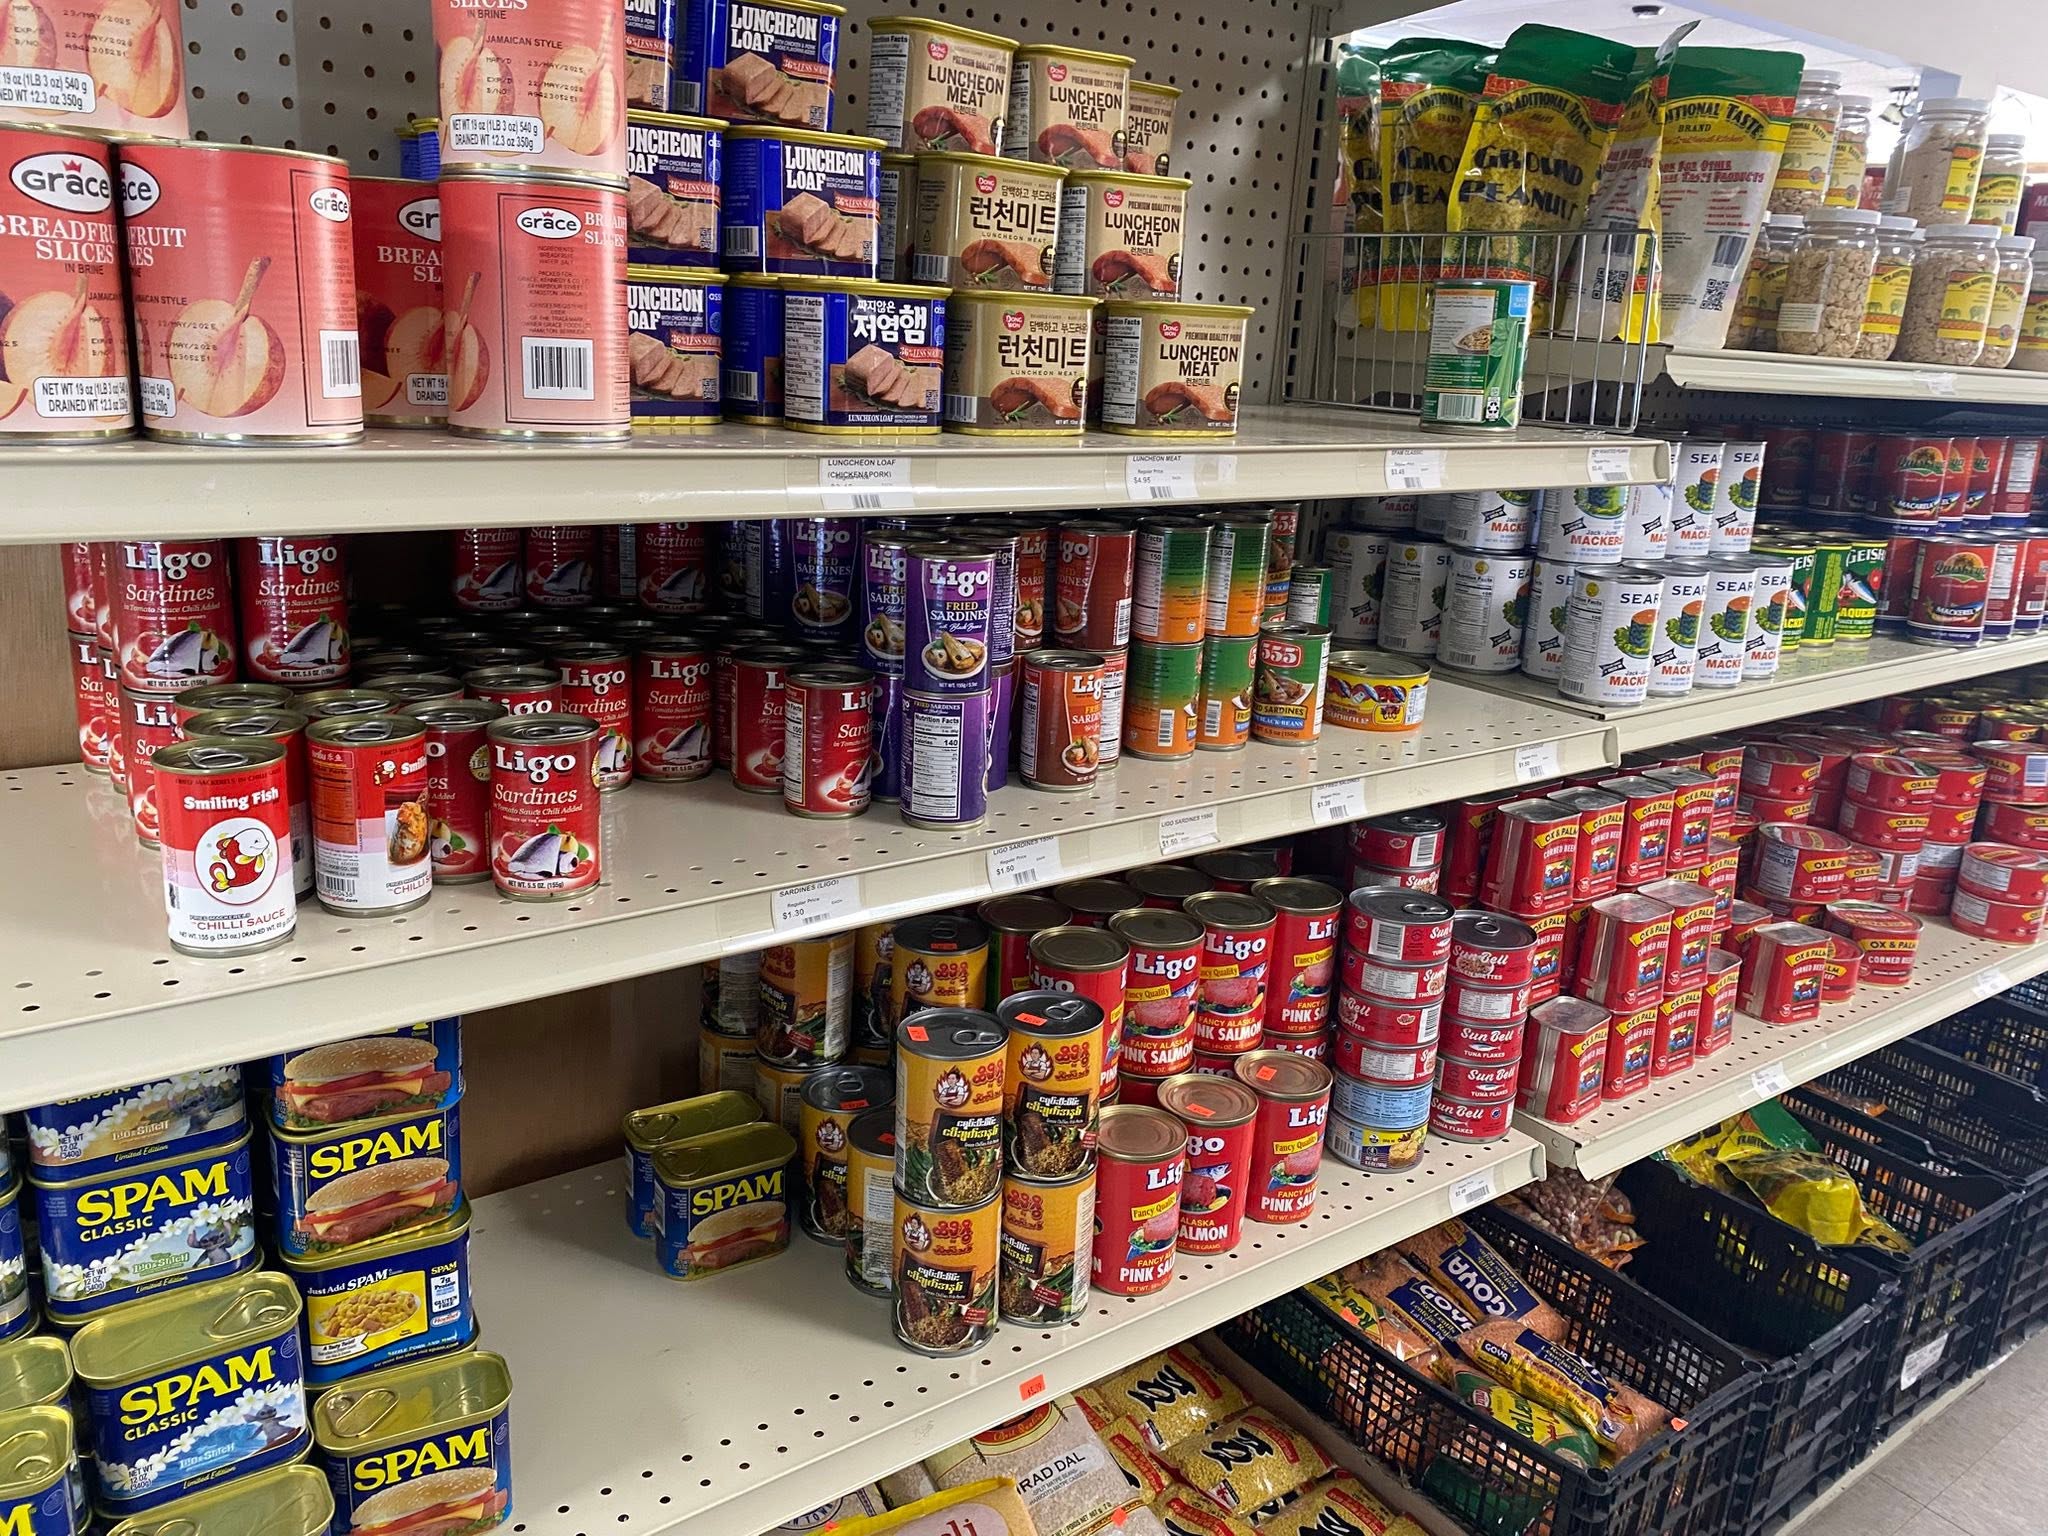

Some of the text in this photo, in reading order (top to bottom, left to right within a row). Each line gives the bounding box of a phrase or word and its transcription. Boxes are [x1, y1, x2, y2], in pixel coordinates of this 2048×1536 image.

[478, 10, 507, 19] BRINE
[730, 4, 819, 41] LUNCHEON
[486, 34, 563, 49] JAMAICAN STYLE
[730, 27, 775, 53] LOAF
[50, 78, 63, 90] oz)
[65, 77, 79, 91] 540
[928, 64, 1005, 96] LUNCHEON
[15, 89, 83, 110] WT oz 350g
[946, 84, 986, 109] MEAT
[1049, 86, 1123, 112] LUNCHEON
[1067, 104, 1106, 123] MEAT
[520, 121, 531, 133] 540
[1127, 115, 1169, 135] CHEON
[1678, 123, 1712, 133] BRAND
[480, 136, 490, 145] WT
[628, 126, 704, 159] UNCHEON
[784, 145, 865, 178] LUNCHEON
[1475, 145, 1583, 186] GROUND
[21, 168, 110, 198] Grace
[786, 170, 827, 191] LOAF
[1001, 185, 1030, 200] 담백하고
[313, 197, 348, 214] Grace
[521, 216, 577, 231] Grace
[969, 196, 1057, 236] 런천미트
[1104, 212, 1180, 233] LUNCHEON
[1123, 229, 1163, 248] MEAT
[36, 238, 114, 264] SLICES
[77, 264, 104, 275] BRINE
[628, 285, 705, 314] UNCHEON
[855, 299, 896, 314] 짜지않은
[852, 304, 928, 345] 저염햄
[1029, 320, 1059, 334] 담백하고
[997, 333, 1087, 370] 런천미트
[1159, 343, 1239, 364] LUNCHEON
[1010, 369, 1055, 377] LUNCHEON
[1178, 361, 1220, 378] MEAT
[42, 383, 73, 396] NET WT
[48, 399, 99, 413] DRAINED WT
[879, 415, 894, 424] LOAF
[828, 458, 896, 468] LUNGCHEON LOAF
[1132, 455, 1164, 463] LUNCHEON
[124, 544, 213, 580] Ligo
[258, 542, 338, 575] Ligo
[259, 579, 340, 598] Sardines
[929, 563, 990, 598] Ligo
[125, 583, 215, 604] Sardines
[929, 609, 990, 622] SARDINES
[946, 601, 979, 611] FRIED
[1260, 643, 1298, 664] 555
[562, 667, 627, 696] Ligo
[650, 659, 711, 687] Ligo
[1264, 705, 1304, 717] SARDINES
[1281, 718, 1304, 728] BEANS
[495, 745, 577, 784] Ligo
[183, 786, 280, 811] Smiling Fish
[494, 783, 578, 806] Sardines
[542, 807, 560, 816] Chili
[560, 803, 584, 815] Added
[1161, 815, 1201, 829] LIGO SARDINES
[1008, 837, 1039, 853] SARDINES
[996, 864, 1015, 875] $1.50
[779, 879, 840, 898] SARDINES (LIGO)
[1812, 875, 1836, 884] CORNED
[196, 907, 286, 932] CHILLI SAUCE
[782, 908, 805, 920] $1.30
[1205, 932, 1267, 961] Ligo
[1869, 941, 1887, 949] OX
[1135, 952, 1198, 980] Ligo
[1480, 950, 1508, 966] Bell
[1868, 955, 1901, 965] CORNED
[1213, 966, 1239, 978] Quality
[1144, 987, 1170, 999] Quality
[1130, 1038, 1189, 1050] FANCY ALASKA
[1461, 1027, 1514, 1042] Sun Bell
[1463, 1050, 1506, 1059] TUNA FLAKES
[1468, 1067, 1516, 1083] Sun Bell
[1471, 1090, 1489, 1098] TUNA
[1450, 1124, 1474, 1135] FLAKES
[143, 1145, 169, 1157] Edition
[310, 1119, 443, 1180] SPAM
[1275, 1142, 1295, 1154] Fancy
[75, 1161, 230, 1228] SPAM
[692, 1170, 783, 1216] SPAM
[1261, 1196, 1293, 1212] PINK
[79, 1214, 154, 1244] CLASSIC
[1181, 1216, 1216, 1228] ALASKA
[431, 1260, 458, 1276] SPAM
[1137, 1255, 1164, 1268] FANCY
[326, 1283, 346, 1295] Add
[346, 1268, 389, 1292] SPAM
[1119, 1267, 1154, 1283] PINK
[1447, 1255, 1506, 1317] GOYA
[1483, 1342, 1511, 1364] GOYA
[119, 1345, 277, 1427] SPAM
[123, 1407, 200, 1442] CLASSIC
[353, 1428, 490, 1492] SPAM
[1054, 1451, 1087, 1473] DAL
[804, 1500, 835, 1523] TOWN
